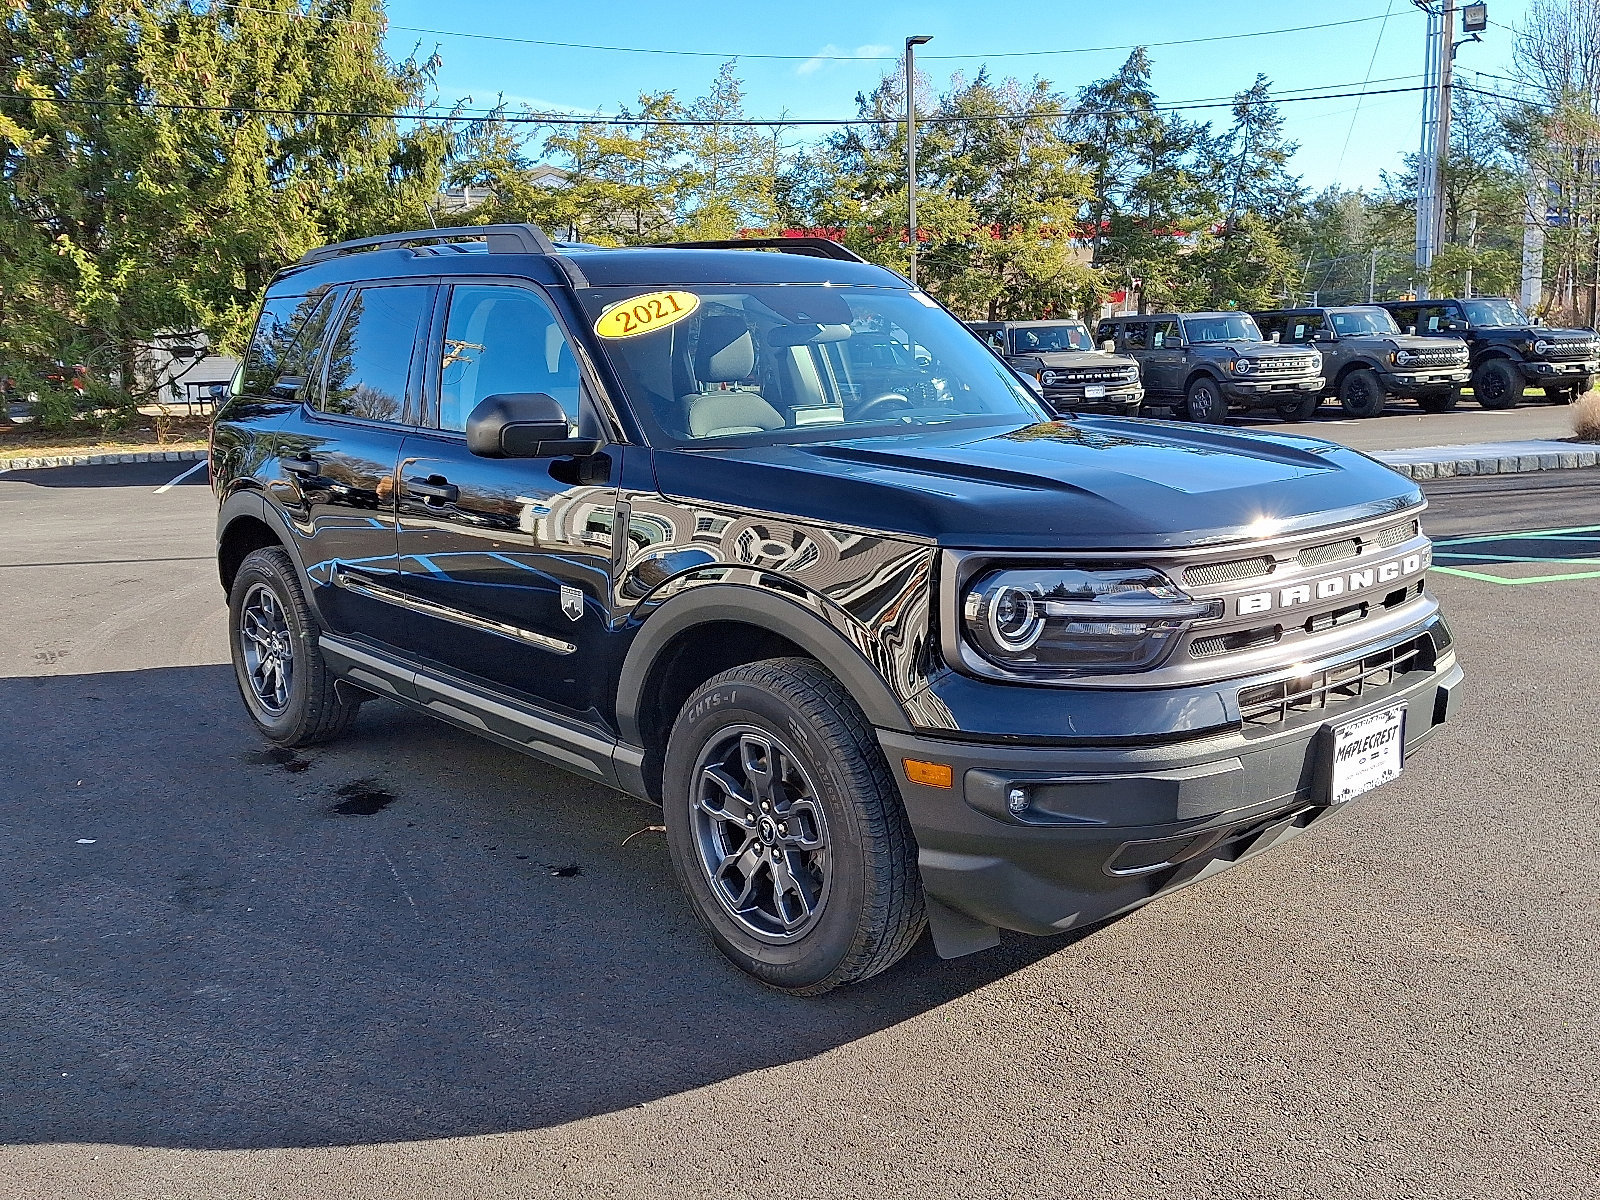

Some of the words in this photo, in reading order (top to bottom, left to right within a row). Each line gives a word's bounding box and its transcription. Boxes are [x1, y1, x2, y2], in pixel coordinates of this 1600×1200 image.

[616, 295, 683, 332] 2021
[1237, 554, 1421, 616] BRONCO
[1336, 725, 1399, 763] MAPLECREST
